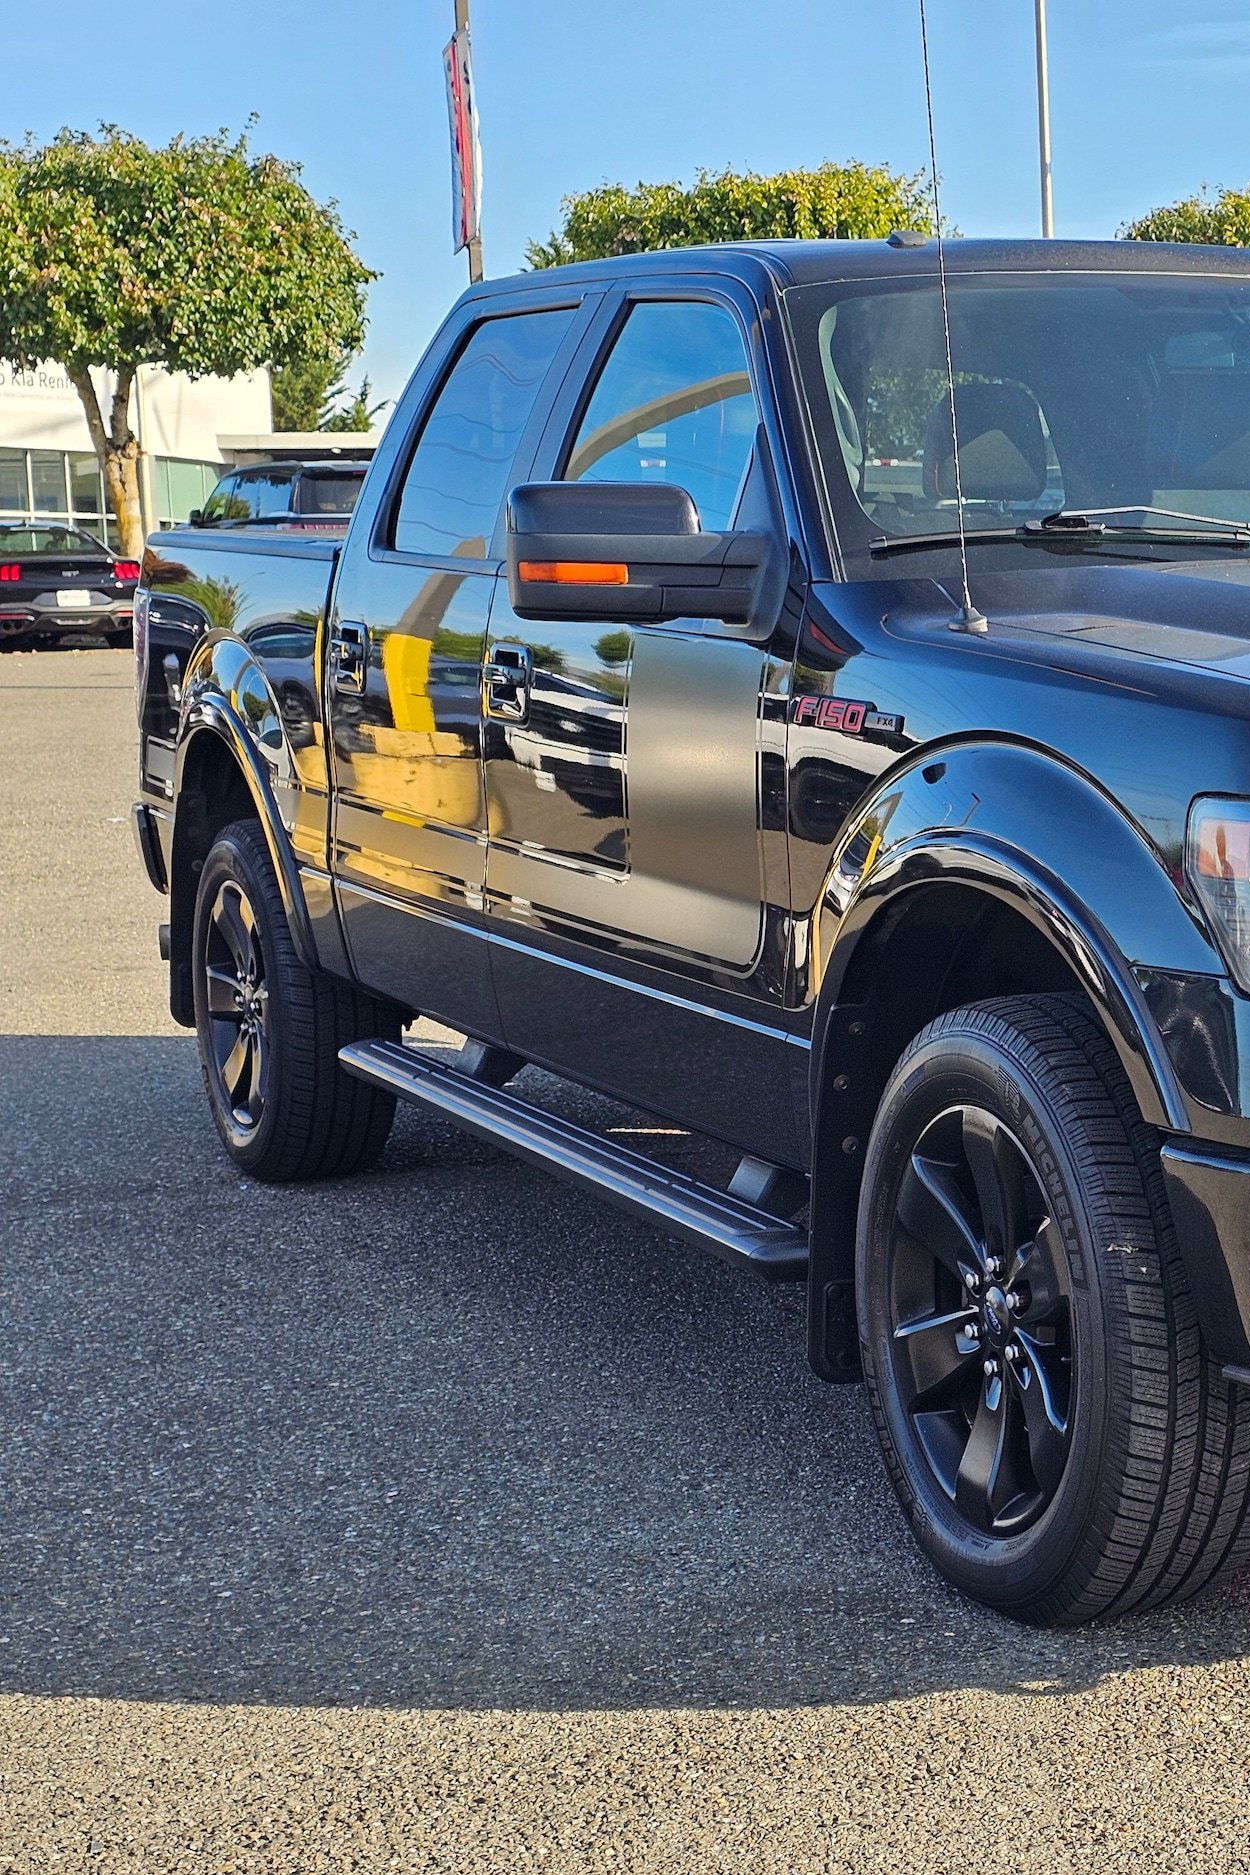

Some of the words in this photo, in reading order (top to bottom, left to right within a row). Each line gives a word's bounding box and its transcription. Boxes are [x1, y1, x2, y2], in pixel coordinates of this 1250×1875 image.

[793, 694, 867, 734] F-150
[876, 715, 894, 728] FX4
[1021, 1112, 1086, 1281] MICHELIN
